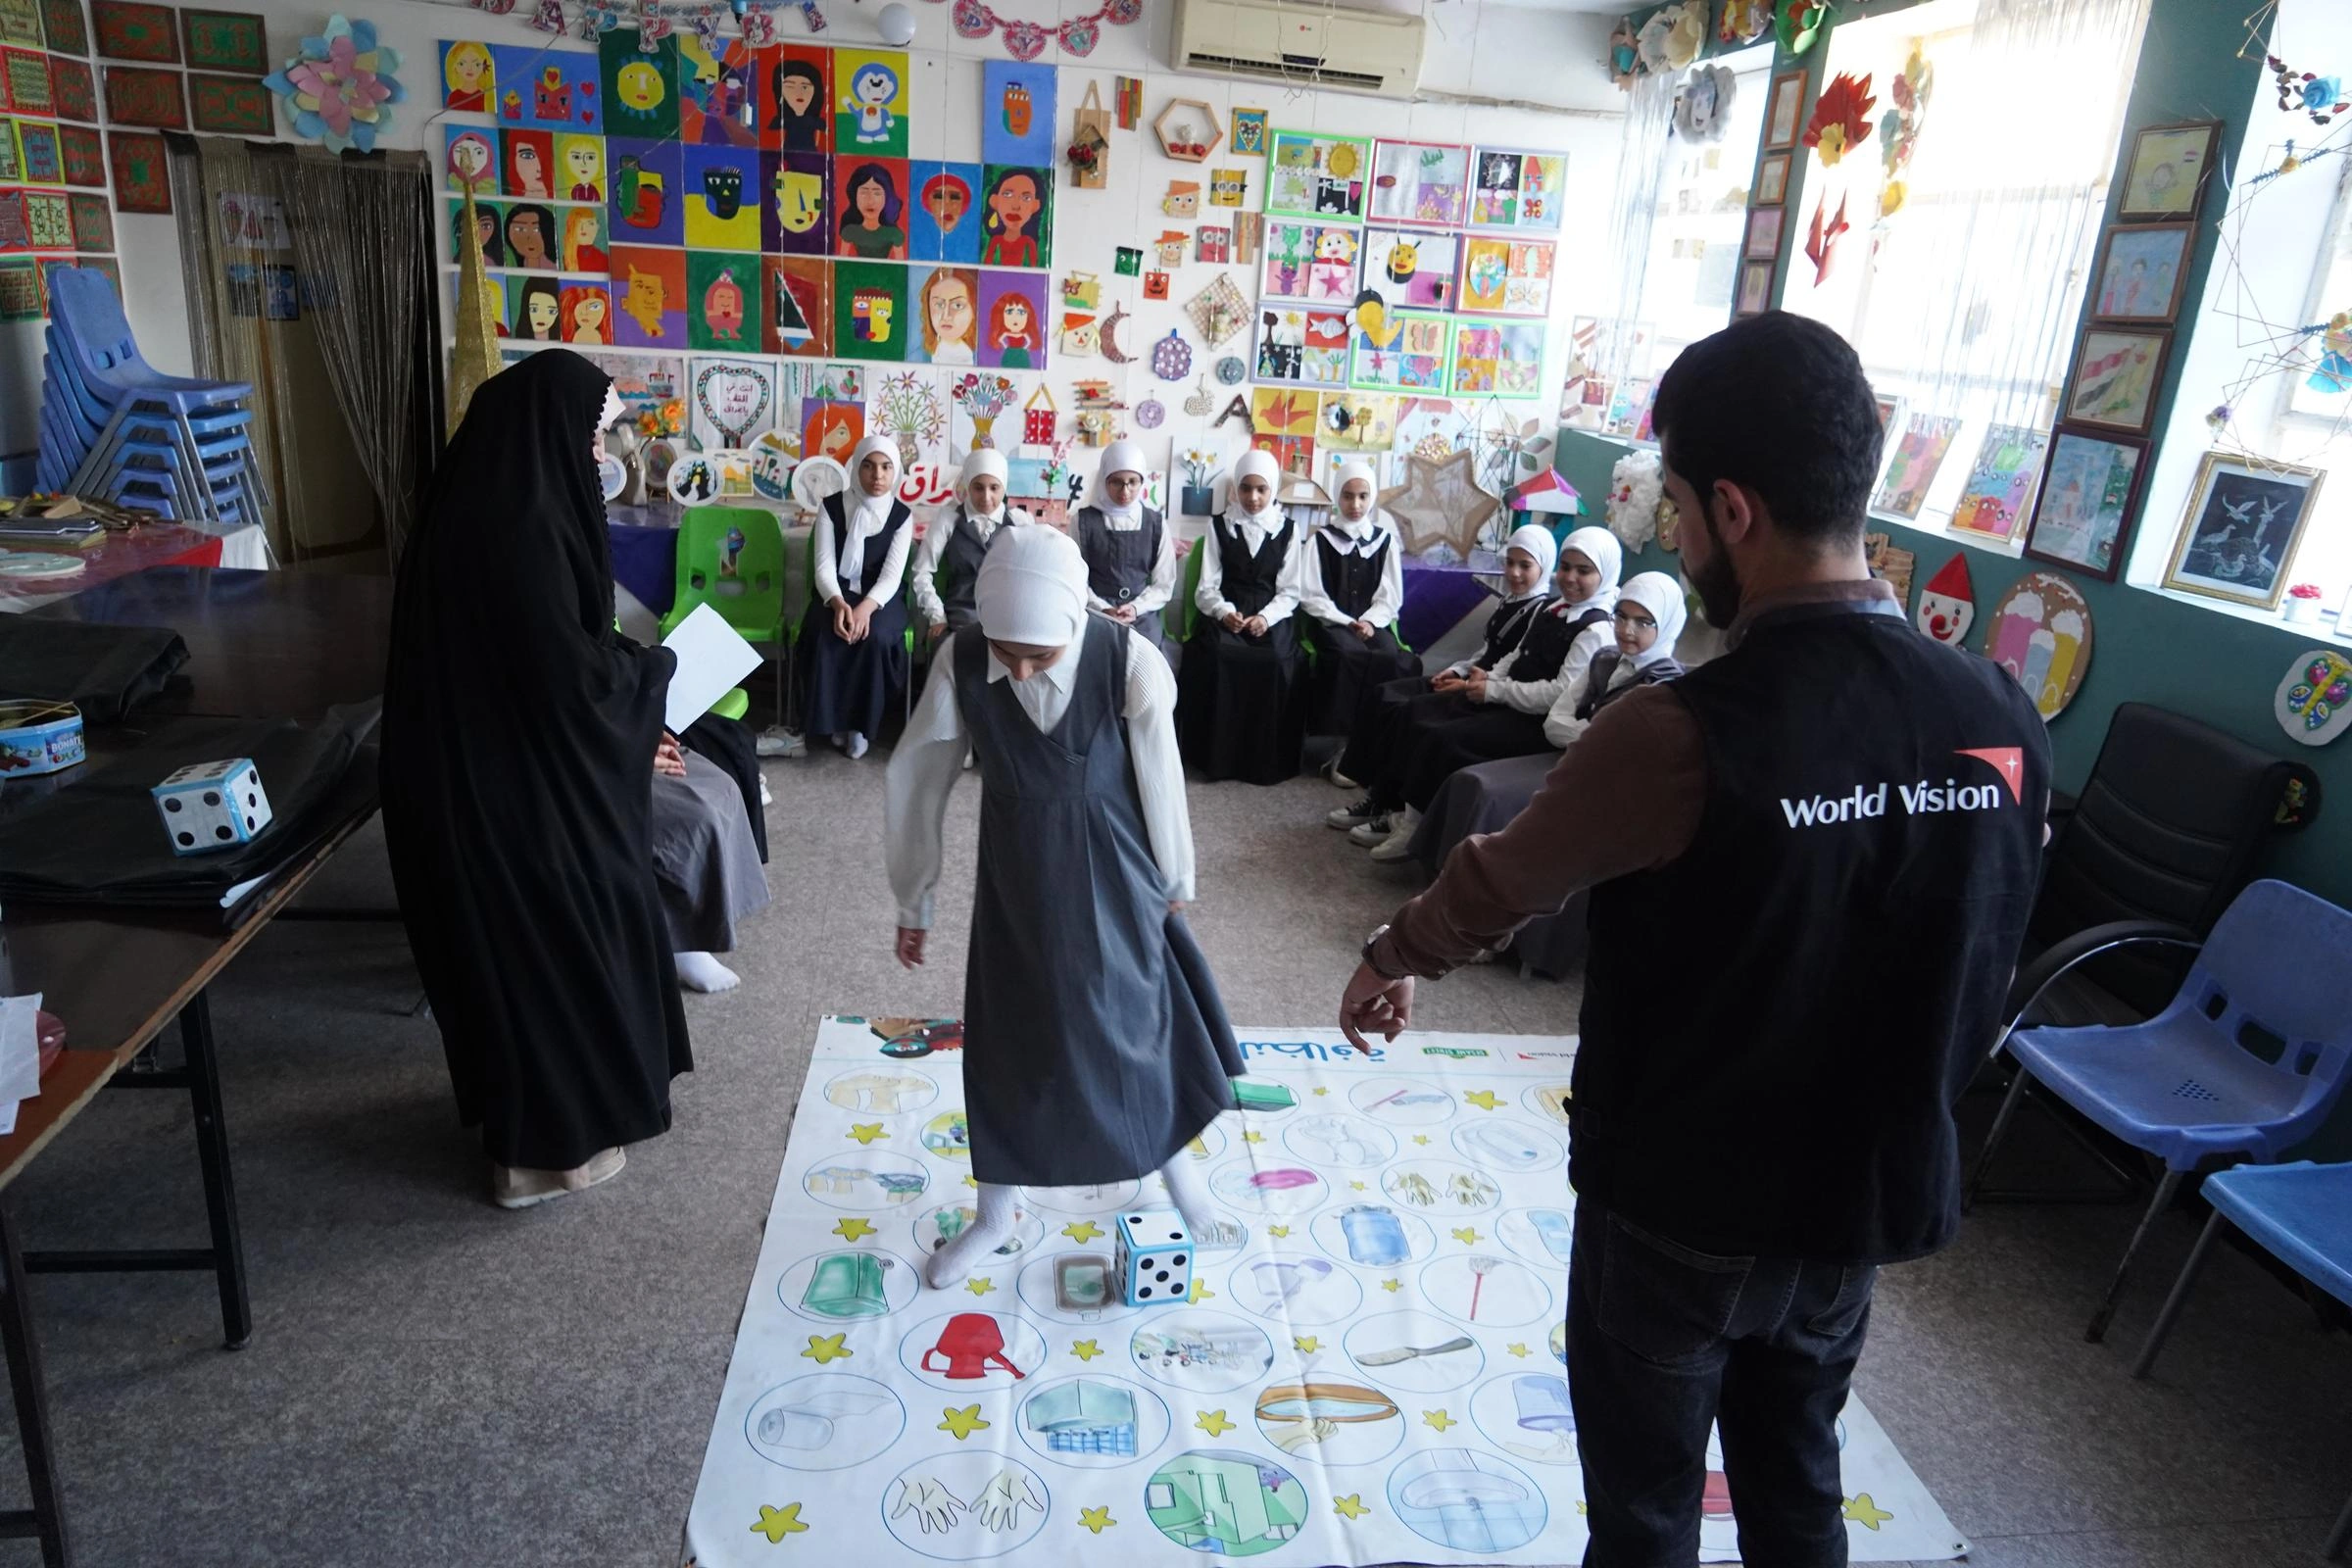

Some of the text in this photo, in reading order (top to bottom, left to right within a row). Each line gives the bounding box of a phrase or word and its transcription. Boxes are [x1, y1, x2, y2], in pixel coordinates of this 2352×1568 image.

[1214, 393, 1255, 434] A
[900, 466, 954, 504] راق
[1781, 778, 1999, 828] World Vision
[1239, 1042, 1386, 1062] لنظافة
